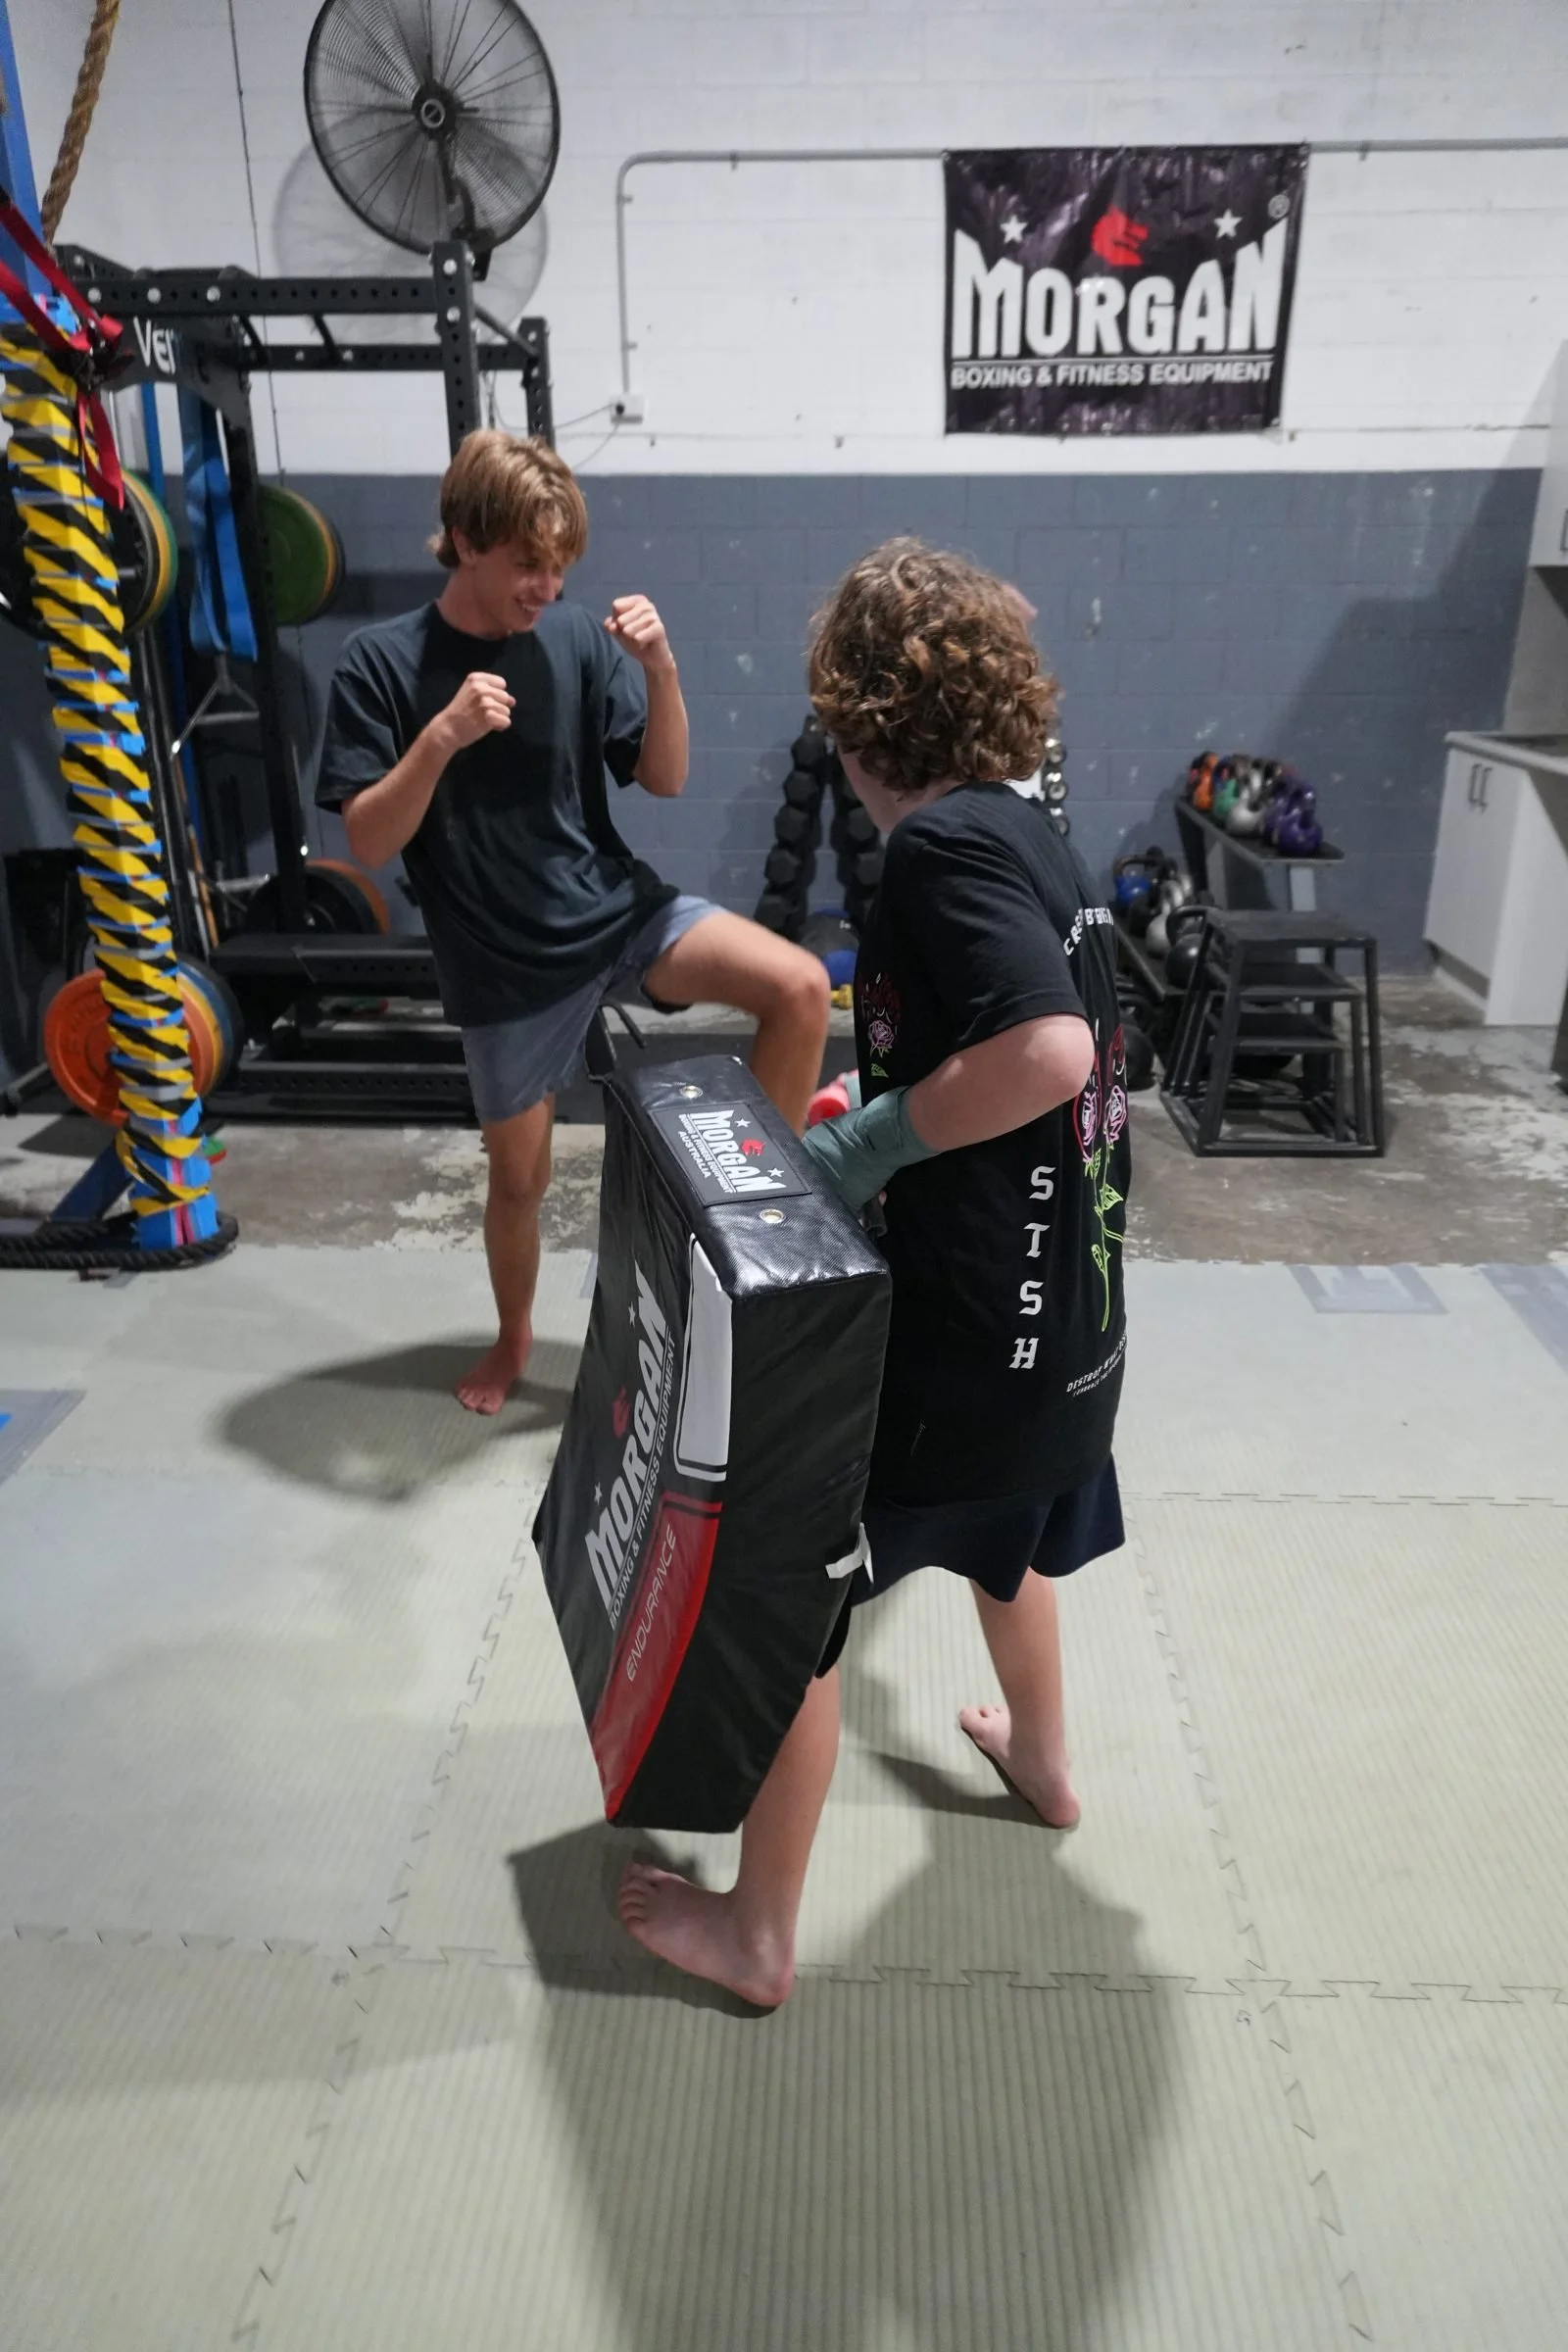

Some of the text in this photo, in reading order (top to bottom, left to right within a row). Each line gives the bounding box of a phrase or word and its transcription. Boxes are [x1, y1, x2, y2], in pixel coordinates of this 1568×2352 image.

[952, 217, 1288, 360] MORGAN
[951, 361, 1273, 390] BOXING & FITNESS EQUIPMENT
[677, 1130, 711, 1178] AUSTRALIA
[690, 1109, 787, 1193] MORGAN
[585, 1257, 666, 1617] MORGAN
[609, 1331, 676, 1631] BOXING & FITNESS EQUIPMENT
[626, 1524, 676, 1682] ENDURANCE
